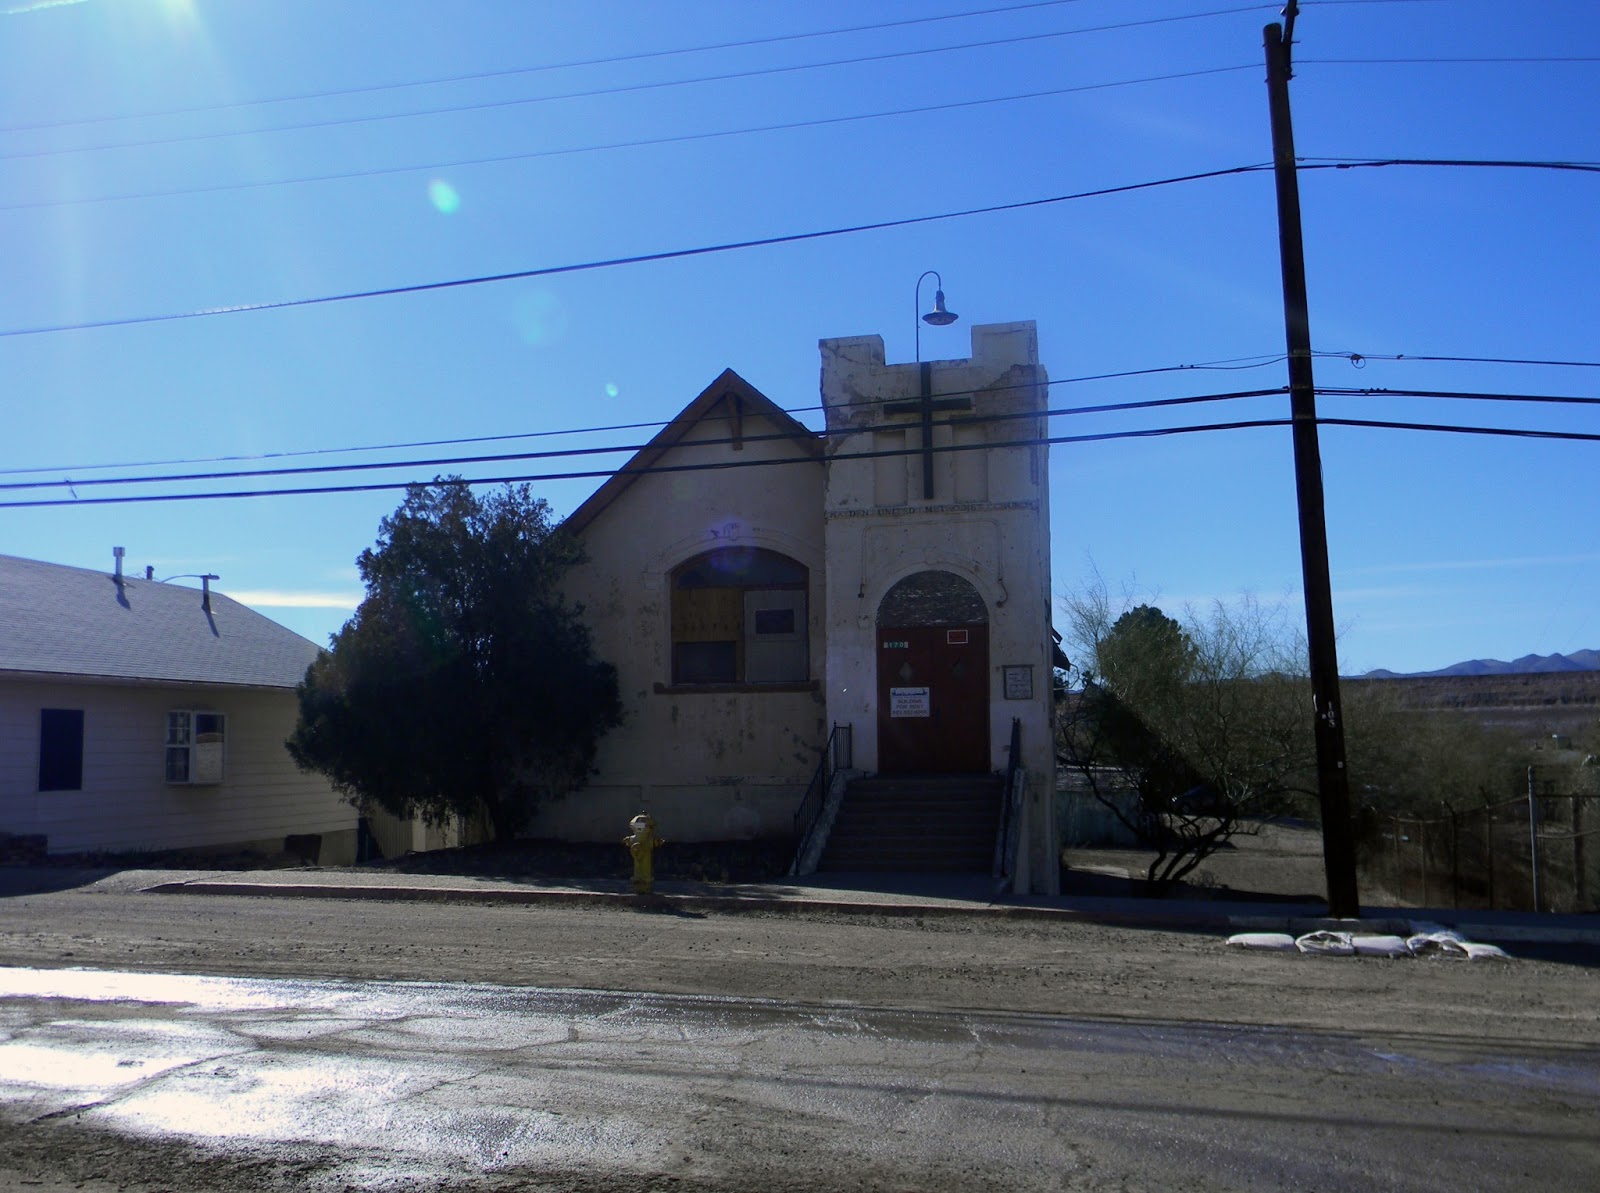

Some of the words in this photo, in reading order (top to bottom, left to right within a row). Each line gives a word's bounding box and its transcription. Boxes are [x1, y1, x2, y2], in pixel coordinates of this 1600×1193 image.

[877, 506, 915, 516] UNITED
[925, 502, 983, 513] METHODIST
[889, 641, 904, 649] 170
